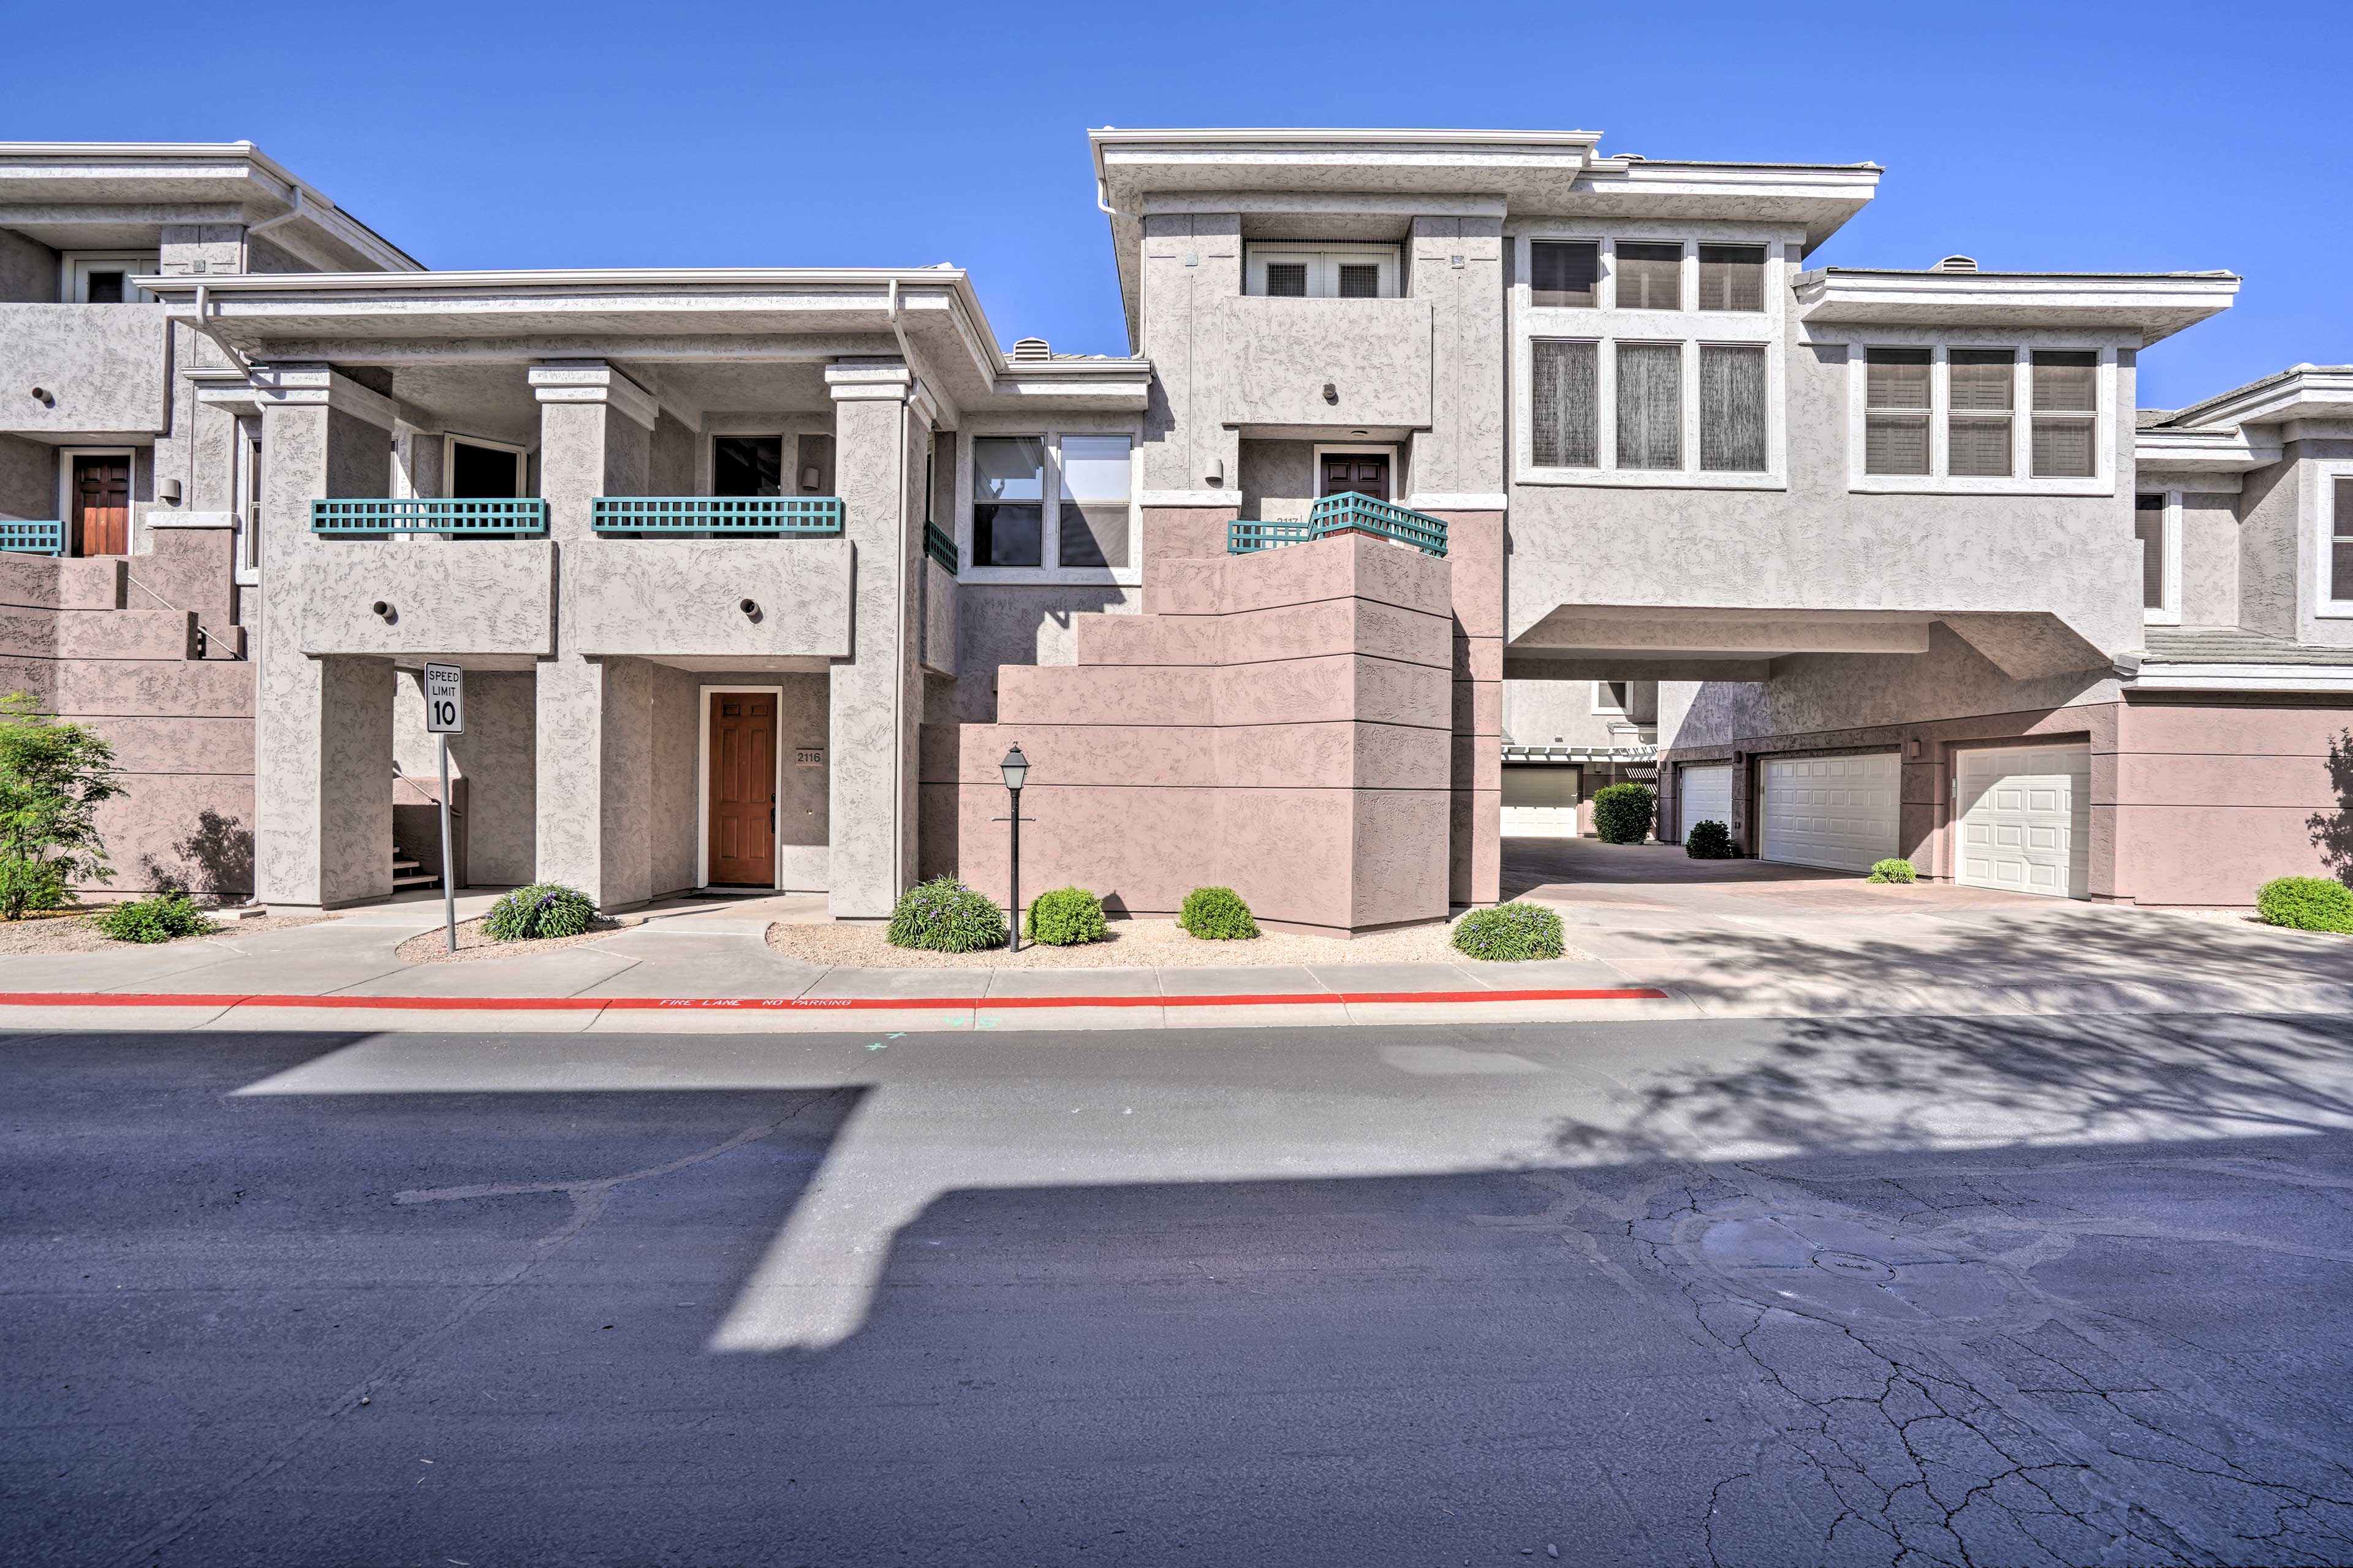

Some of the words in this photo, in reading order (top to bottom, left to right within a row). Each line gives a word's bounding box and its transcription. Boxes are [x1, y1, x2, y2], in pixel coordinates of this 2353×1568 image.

[430, 670, 459, 682] SPEED
[432, 686, 456, 696] LIMIT
[434, 700, 455, 725] 10
[798, 752, 820, 762] 2116
